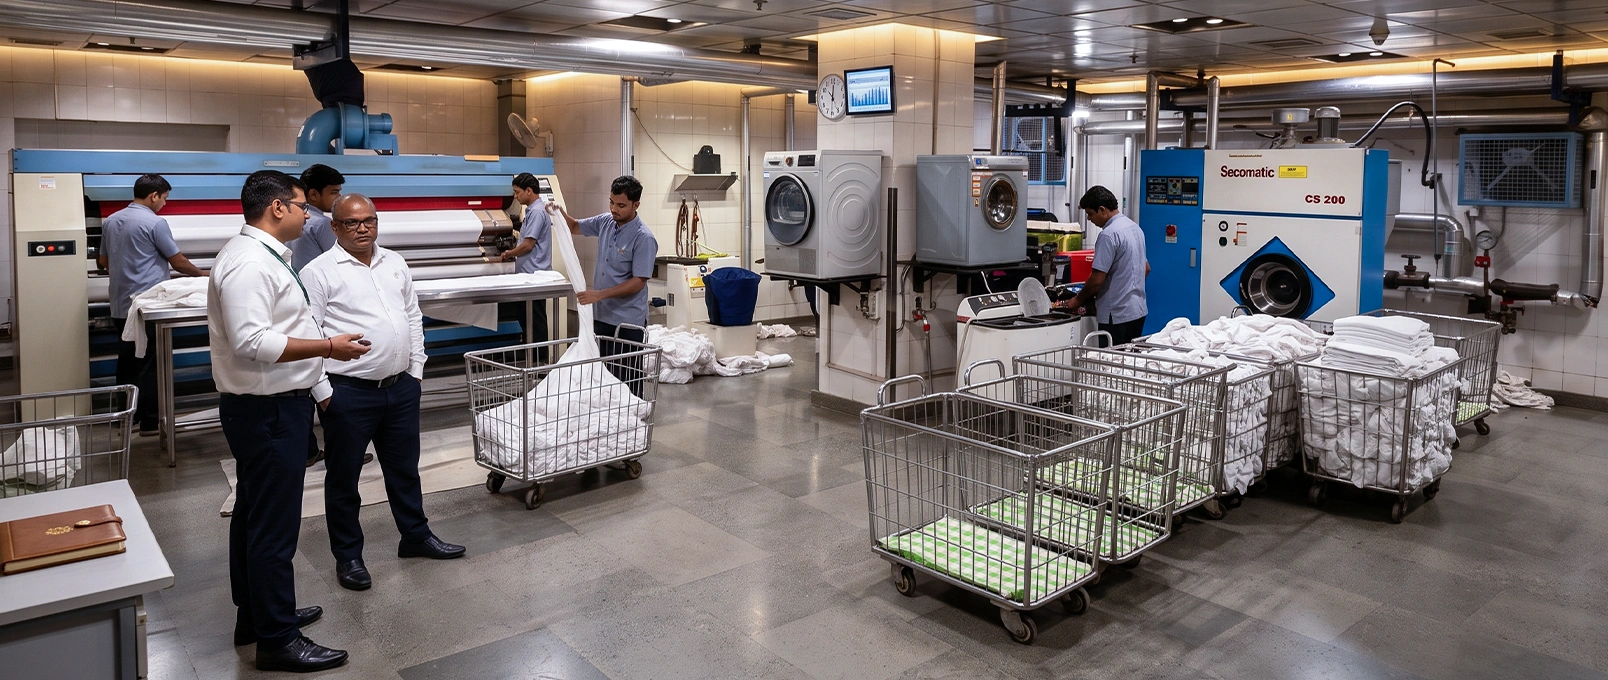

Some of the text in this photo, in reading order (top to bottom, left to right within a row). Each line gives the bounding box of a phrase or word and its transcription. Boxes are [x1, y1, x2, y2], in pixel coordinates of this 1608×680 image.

[1220, 165, 1275, 178] Secomatic
[1305, 194, 1346, 205] CS 200
